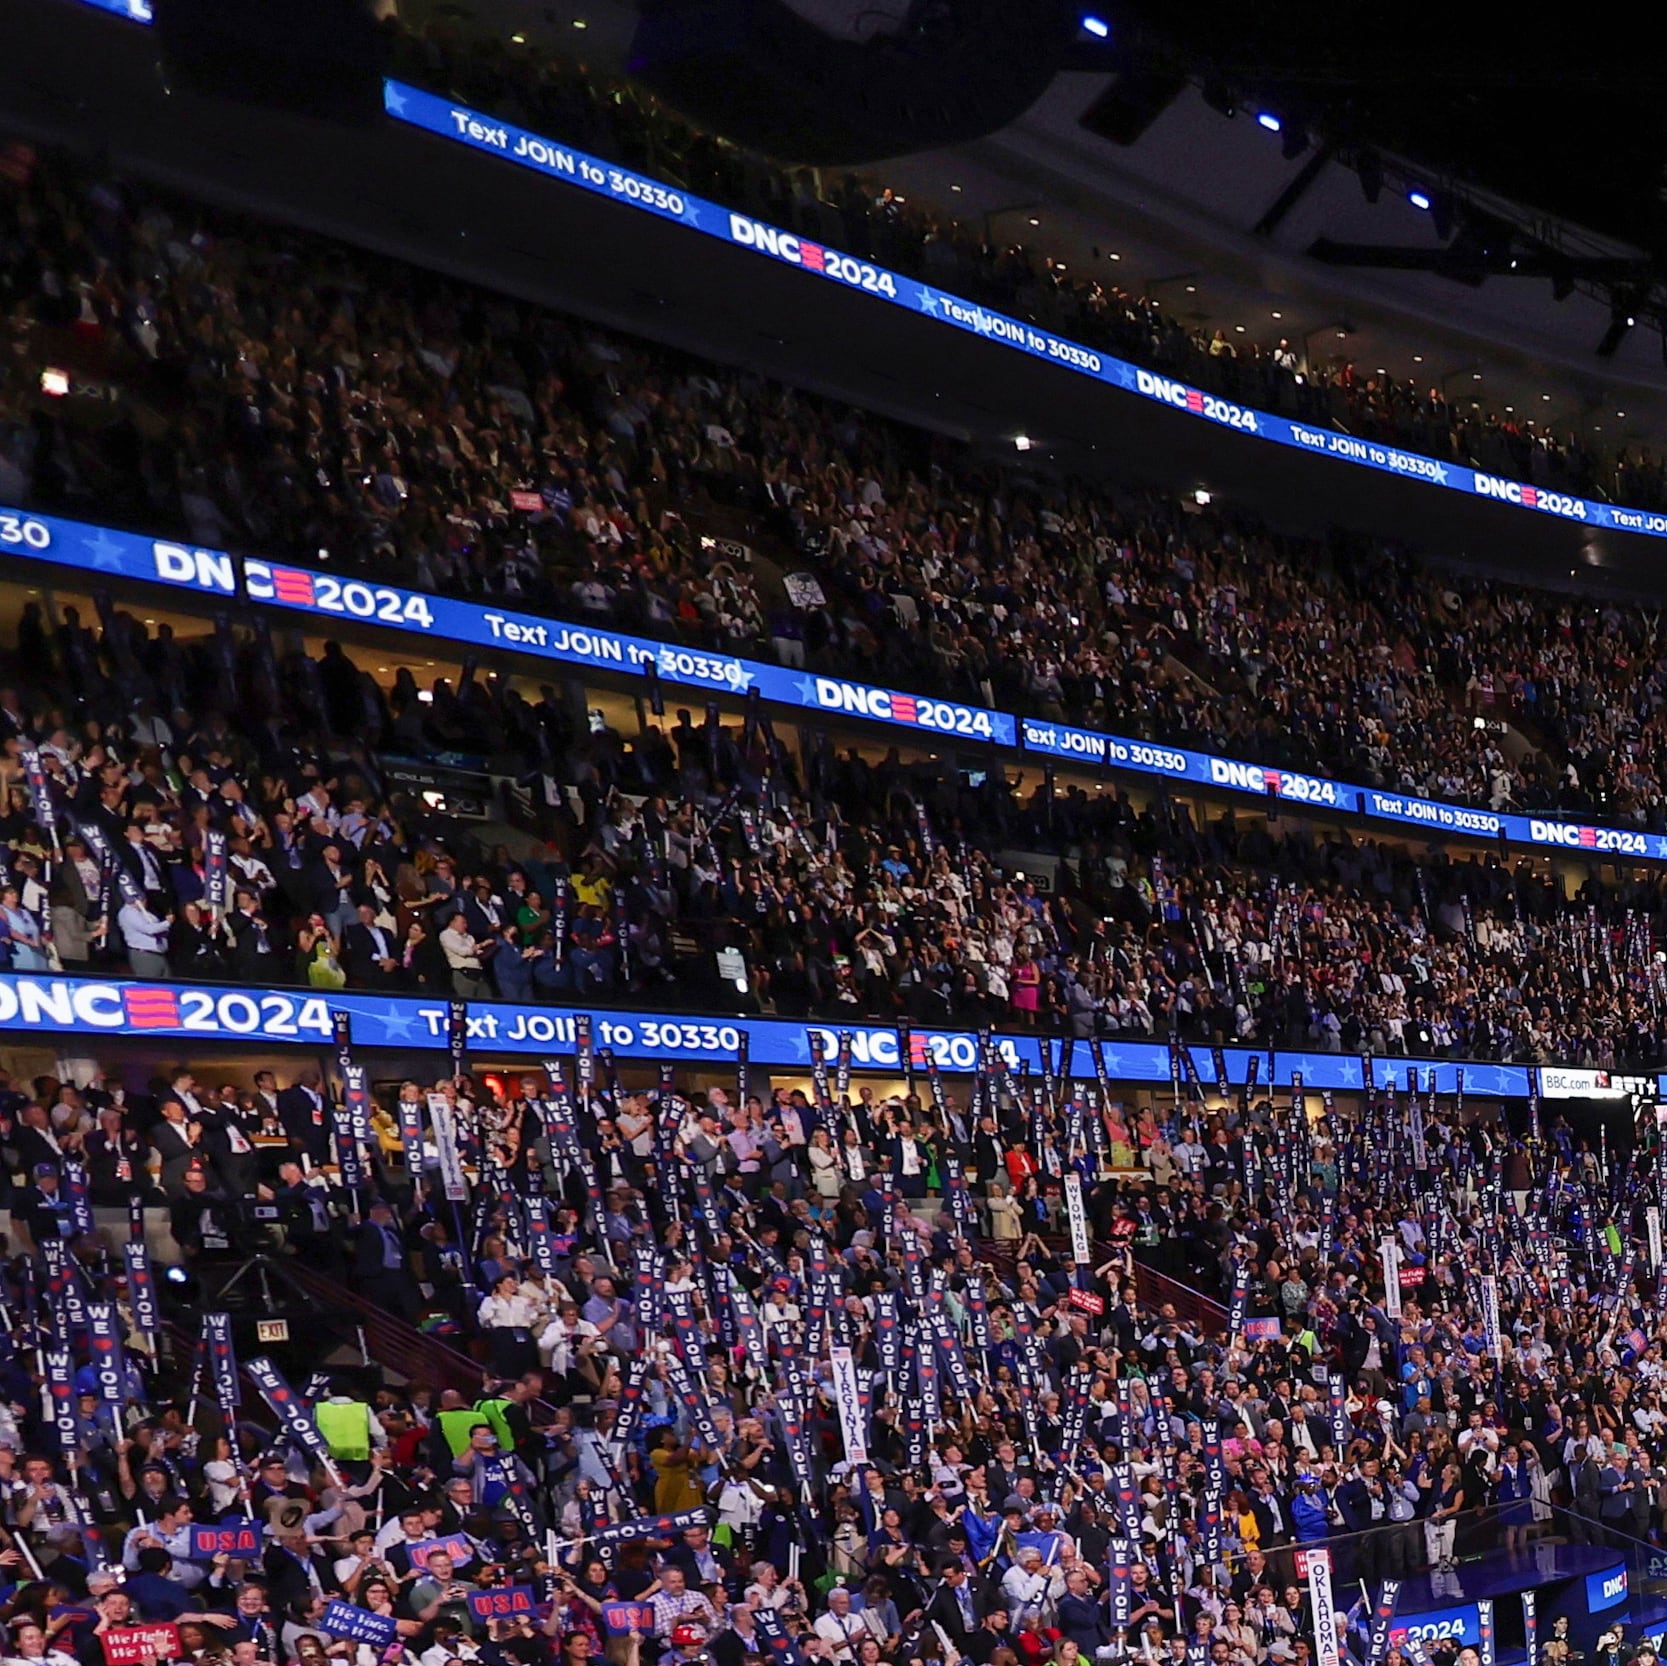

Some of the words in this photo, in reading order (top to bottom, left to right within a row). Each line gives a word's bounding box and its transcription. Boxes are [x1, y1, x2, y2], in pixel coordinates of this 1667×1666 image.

[451, 111, 507, 148] Text
[514, 137, 575, 174] JOIN
[579, 161, 605, 185] to
[609, 171, 684, 214] 30330
[730, 214, 802, 263] DNC
[824, 251, 897, 298] 2024
[1136, 370, 1188, 407] DNC
[1202, 396, 1258, 432] 2024
[1290, 425, 1325, 448] Text
[1328, 437, 1367, 459] JOIN
[1369, 448, 1386, 464] to
[1387, 451, 1437, 478] 30330
[1474, 473, 1522, 503] DNC
[1536, 490, 1587, 519] 2024
[154, 543, 275, 599] DNC
[314, 577, 434, 628] 2024
[484, 614, 547, 646] Text
[554, 630, 622, 661] JOIN
[659, 649, 741, 691] 30330
[816, 678, 892, 718] DNC
[916, 700, 993, 737] 2024
[1210, 758, 1265, 791] DNC
[1280, 774, 1336, 804] 2024
[180, 991, 337, 1037] 2024
[639, 1022, 739, 1052] 30330
[1546, 1076, 1591, 1090] BBC.com
[1066, 1185, 1085, 1251] WYOMING
[1482, 1285, 1495, 1346] NEVADA
[249, 1359, 279, 1388] WE
[287, 1403, 319, 1446] JOE
[839, 1361, 859, 1446] VIRGINIA
[1112, 1540, 1129, 1564] WE
[1114, 1582, 1128, 1620] JOE
[1313, 1565, 1334, 1654] OKLAHOMA
[1603, 1575, 1623, 1599] DNC
